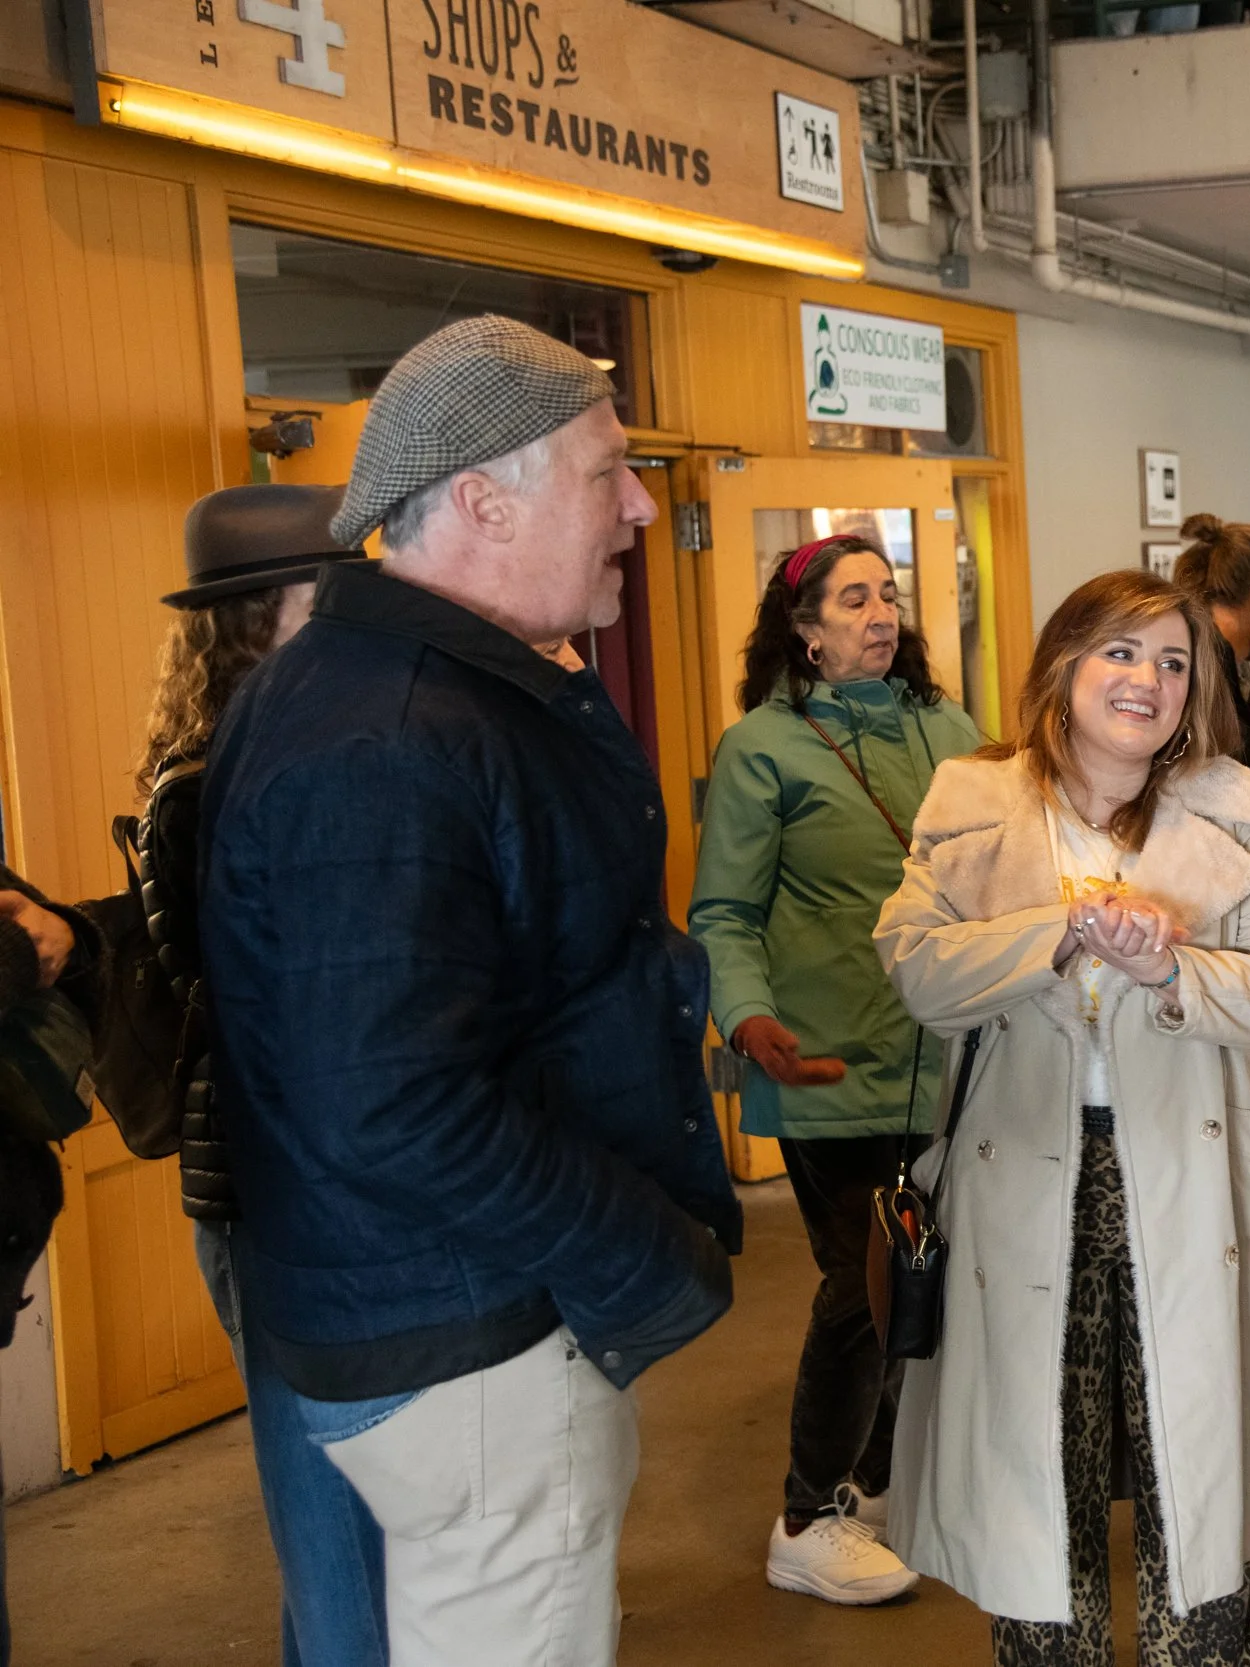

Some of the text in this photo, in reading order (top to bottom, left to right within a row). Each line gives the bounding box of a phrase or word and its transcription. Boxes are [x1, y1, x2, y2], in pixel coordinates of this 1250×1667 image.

[421, 0, 579, 89] SHOPS &
[428, 74, 711, 187] RESTAURANTS
[786, 171, 839, 201] Restrooms
[838, 324, 941, 364] CONSCIOUS WEAR
[842, 368, 861, 387] ECO
[868, 395, 888, 411] AND
